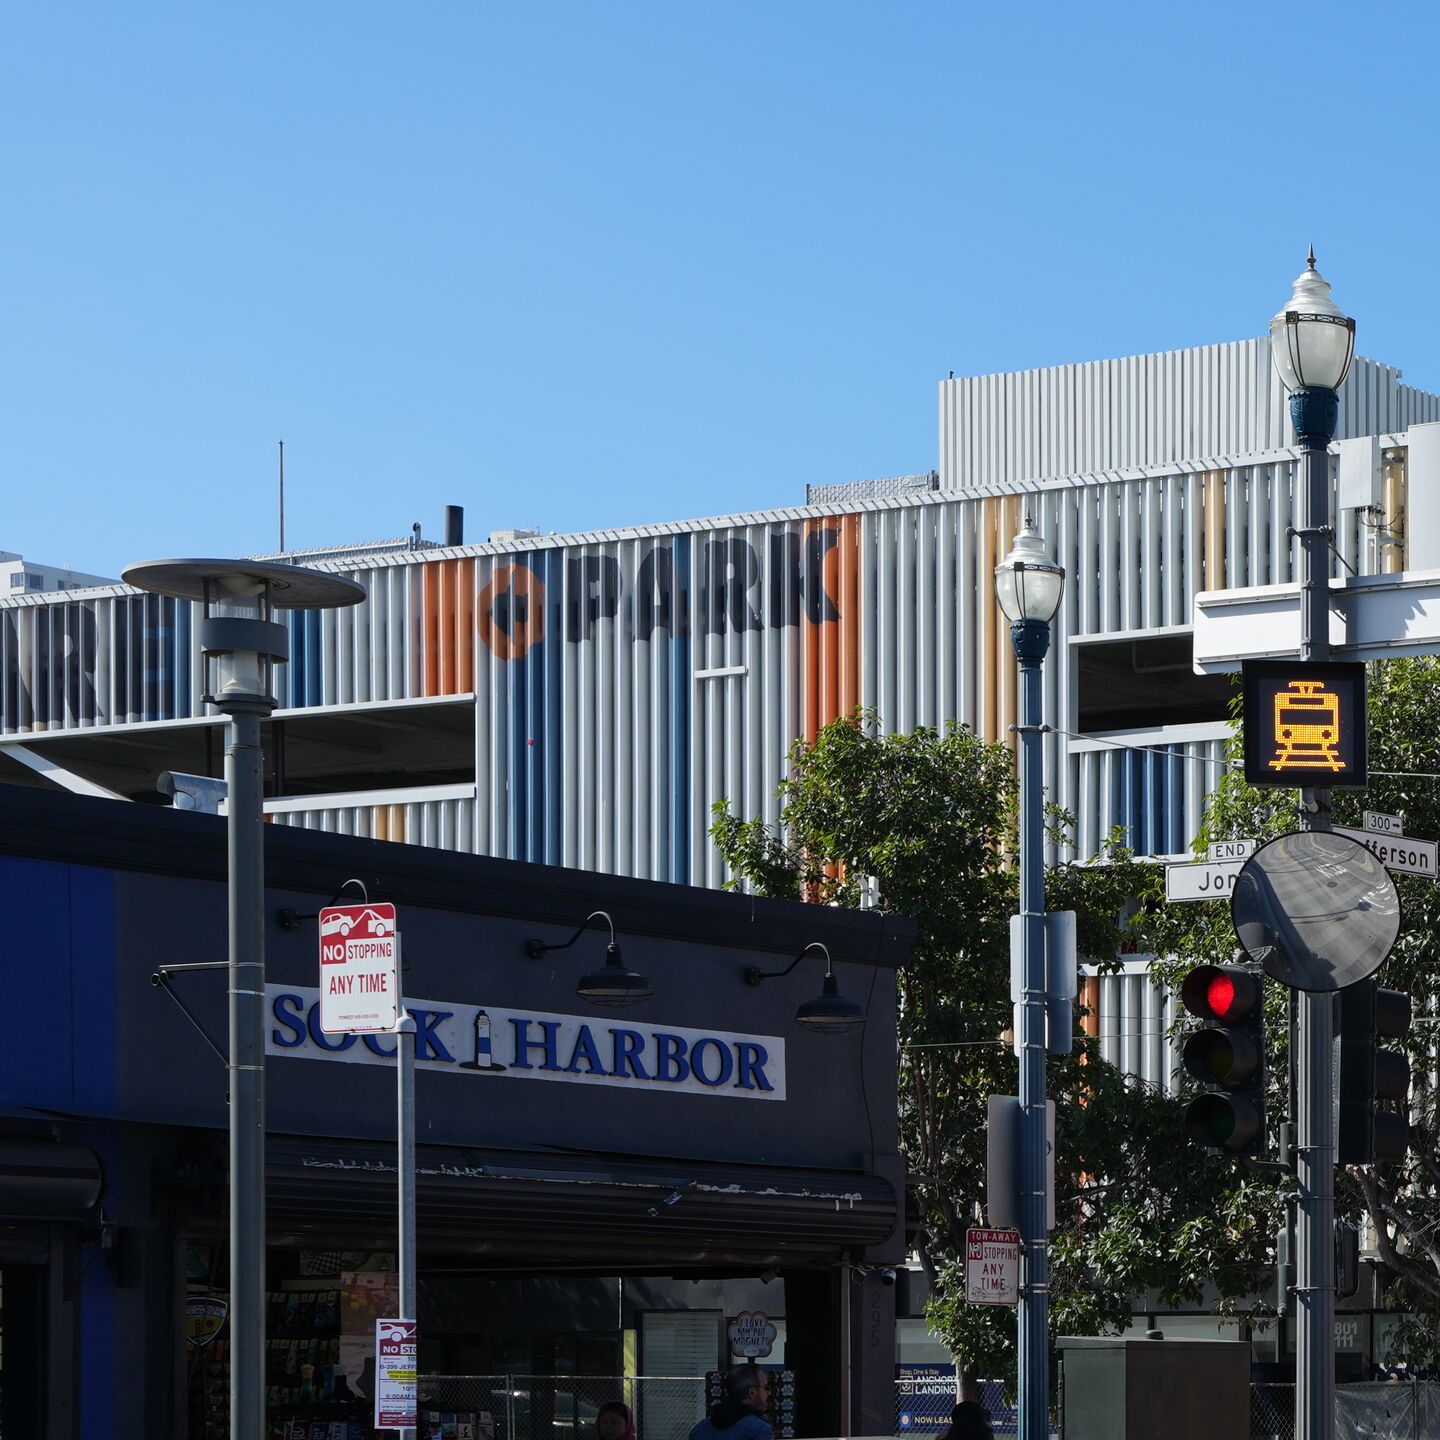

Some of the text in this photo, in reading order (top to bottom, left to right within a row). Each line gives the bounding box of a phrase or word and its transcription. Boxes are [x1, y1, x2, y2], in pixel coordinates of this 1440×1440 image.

[567, 528, 841, 643] PARK
[1371, 815, 1390, 830] 300
[1215, 844, 1245, 858] END
[1198, 872, 1239, 891] Jon
[323, 942, 392, 961] NO STOPPING
[329, 973, 387, 995] ANY TIME
[508, 1017, 775, 1091] HARBOR
[971, 1231, 1017, 1241] TOW-AWAY
[969, 1242, 1017, 1260] NO STOPPING
[983, 1263, 1004, 1275] ANY
[981, 1278, 1006, 1290] TIME
[383, 1345, 398, 1353] NO
[915, 1385, 957, 1394] LANDING
